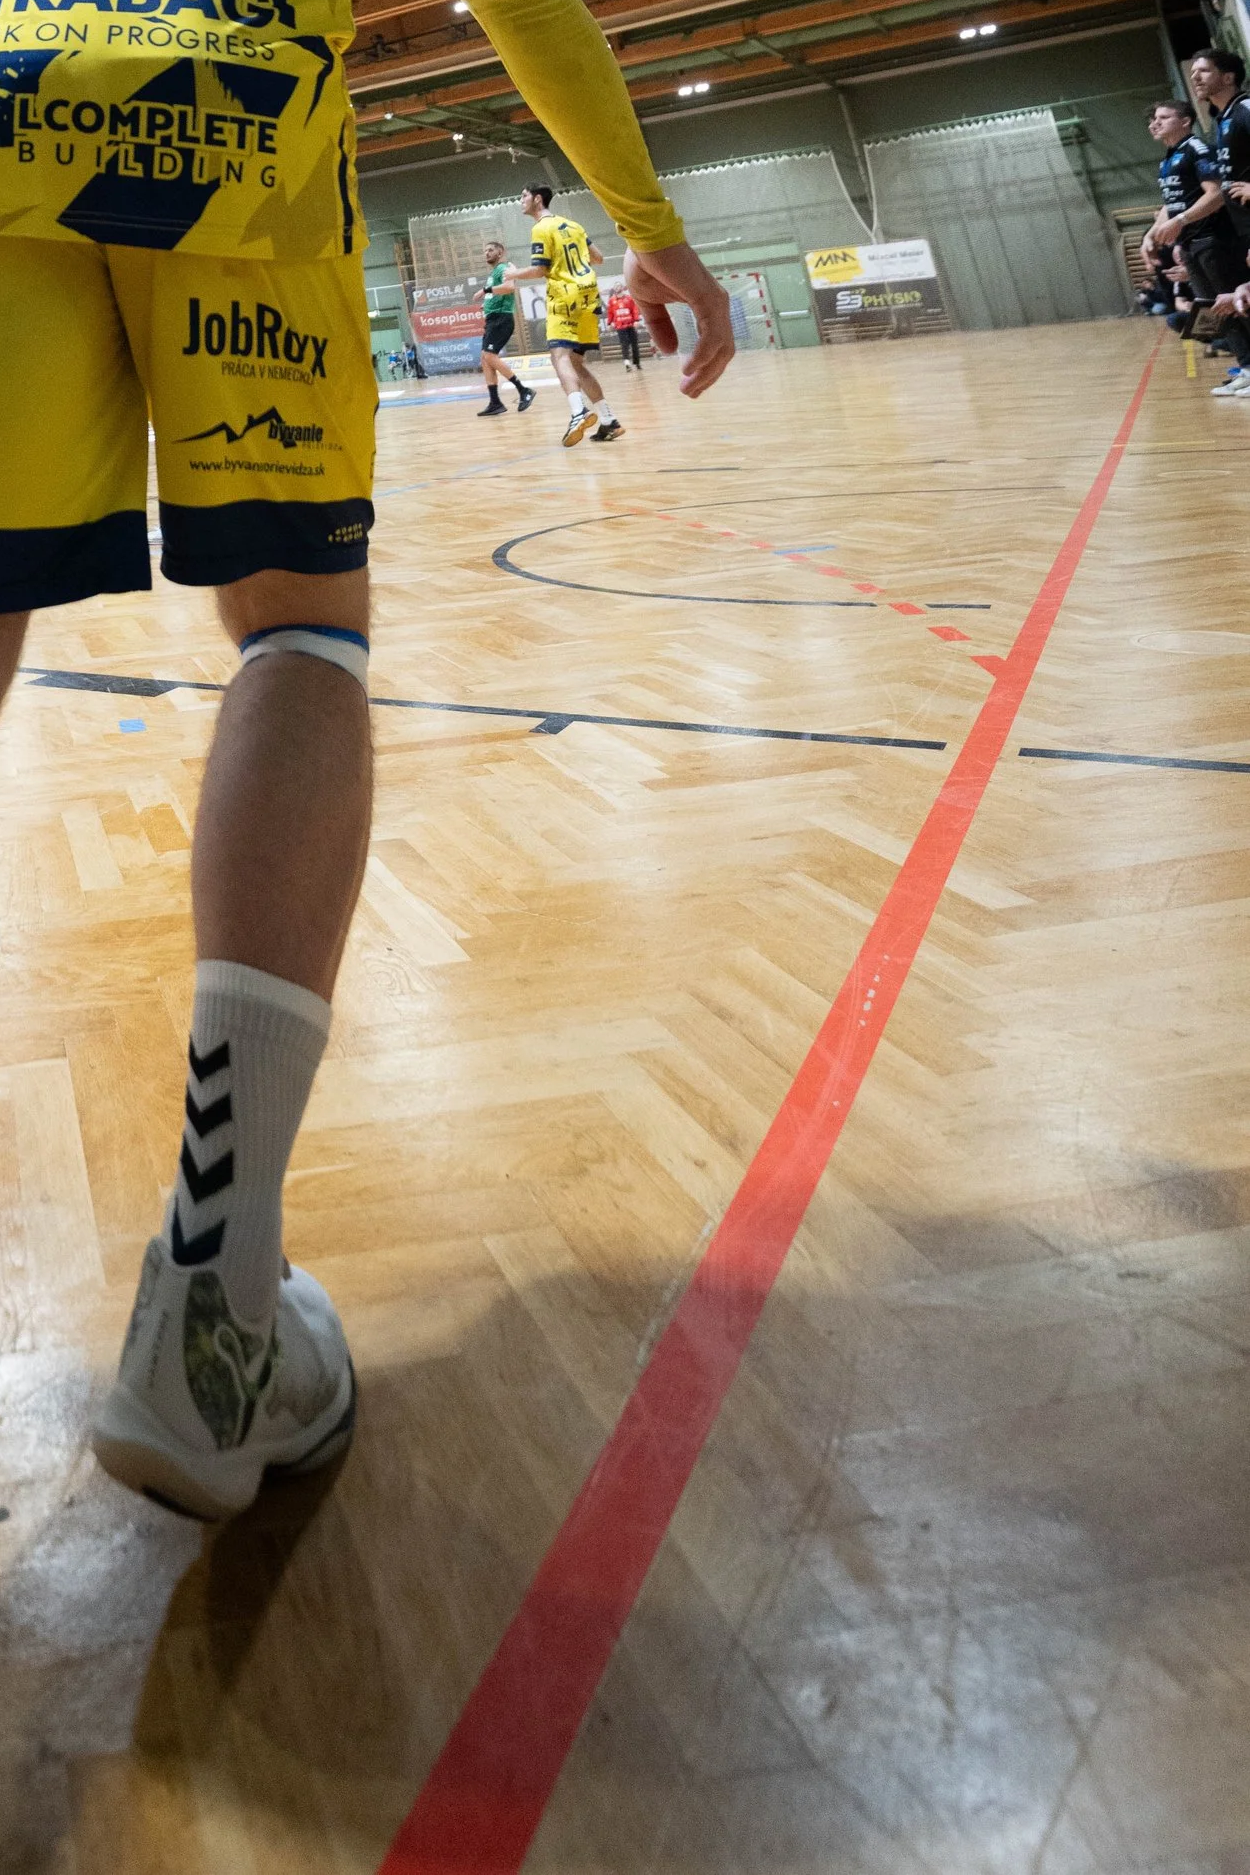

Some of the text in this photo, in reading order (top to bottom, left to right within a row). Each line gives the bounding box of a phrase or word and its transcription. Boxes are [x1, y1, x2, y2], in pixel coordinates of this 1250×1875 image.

[36, 23, 88, 44] ON
[107, 24, 276, 61] PROGRESS
[18, 141, 277, 188] BUILDING
[562, 242, 592, 277] 10
